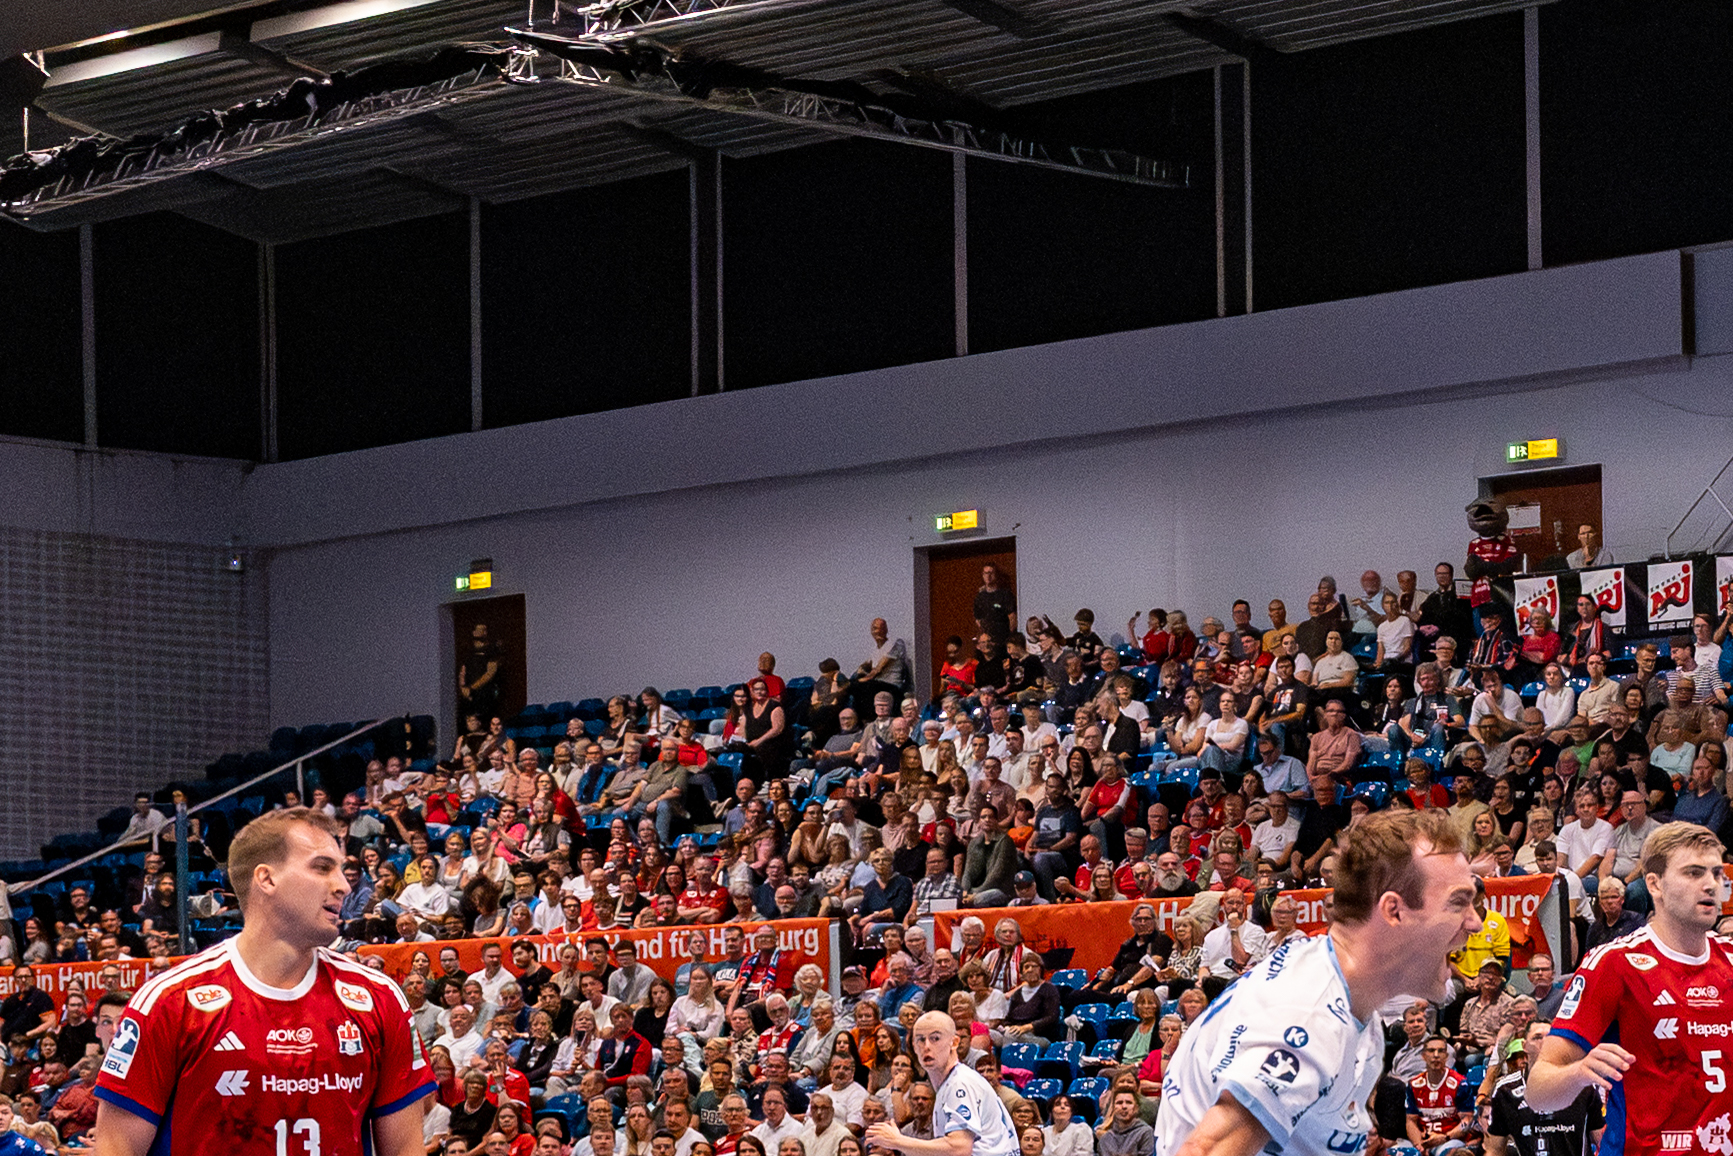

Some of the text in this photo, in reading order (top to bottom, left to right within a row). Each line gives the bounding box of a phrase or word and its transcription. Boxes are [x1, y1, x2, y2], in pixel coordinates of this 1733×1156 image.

[1597, 571, 1621, 612] RJ
[1650, 563, 1690, 618] NRJ
[194, 988, 223, 1002] Dole
[1687, 987, 1708, 998] AOK
[267, 1030, 296, 1042] AOK
[1701, 1050, 1726, 1093] 5
[262, 1073, 363, 1095] Hapag-Lloyd
[1662, 1133, 1692, 1148] WIR
